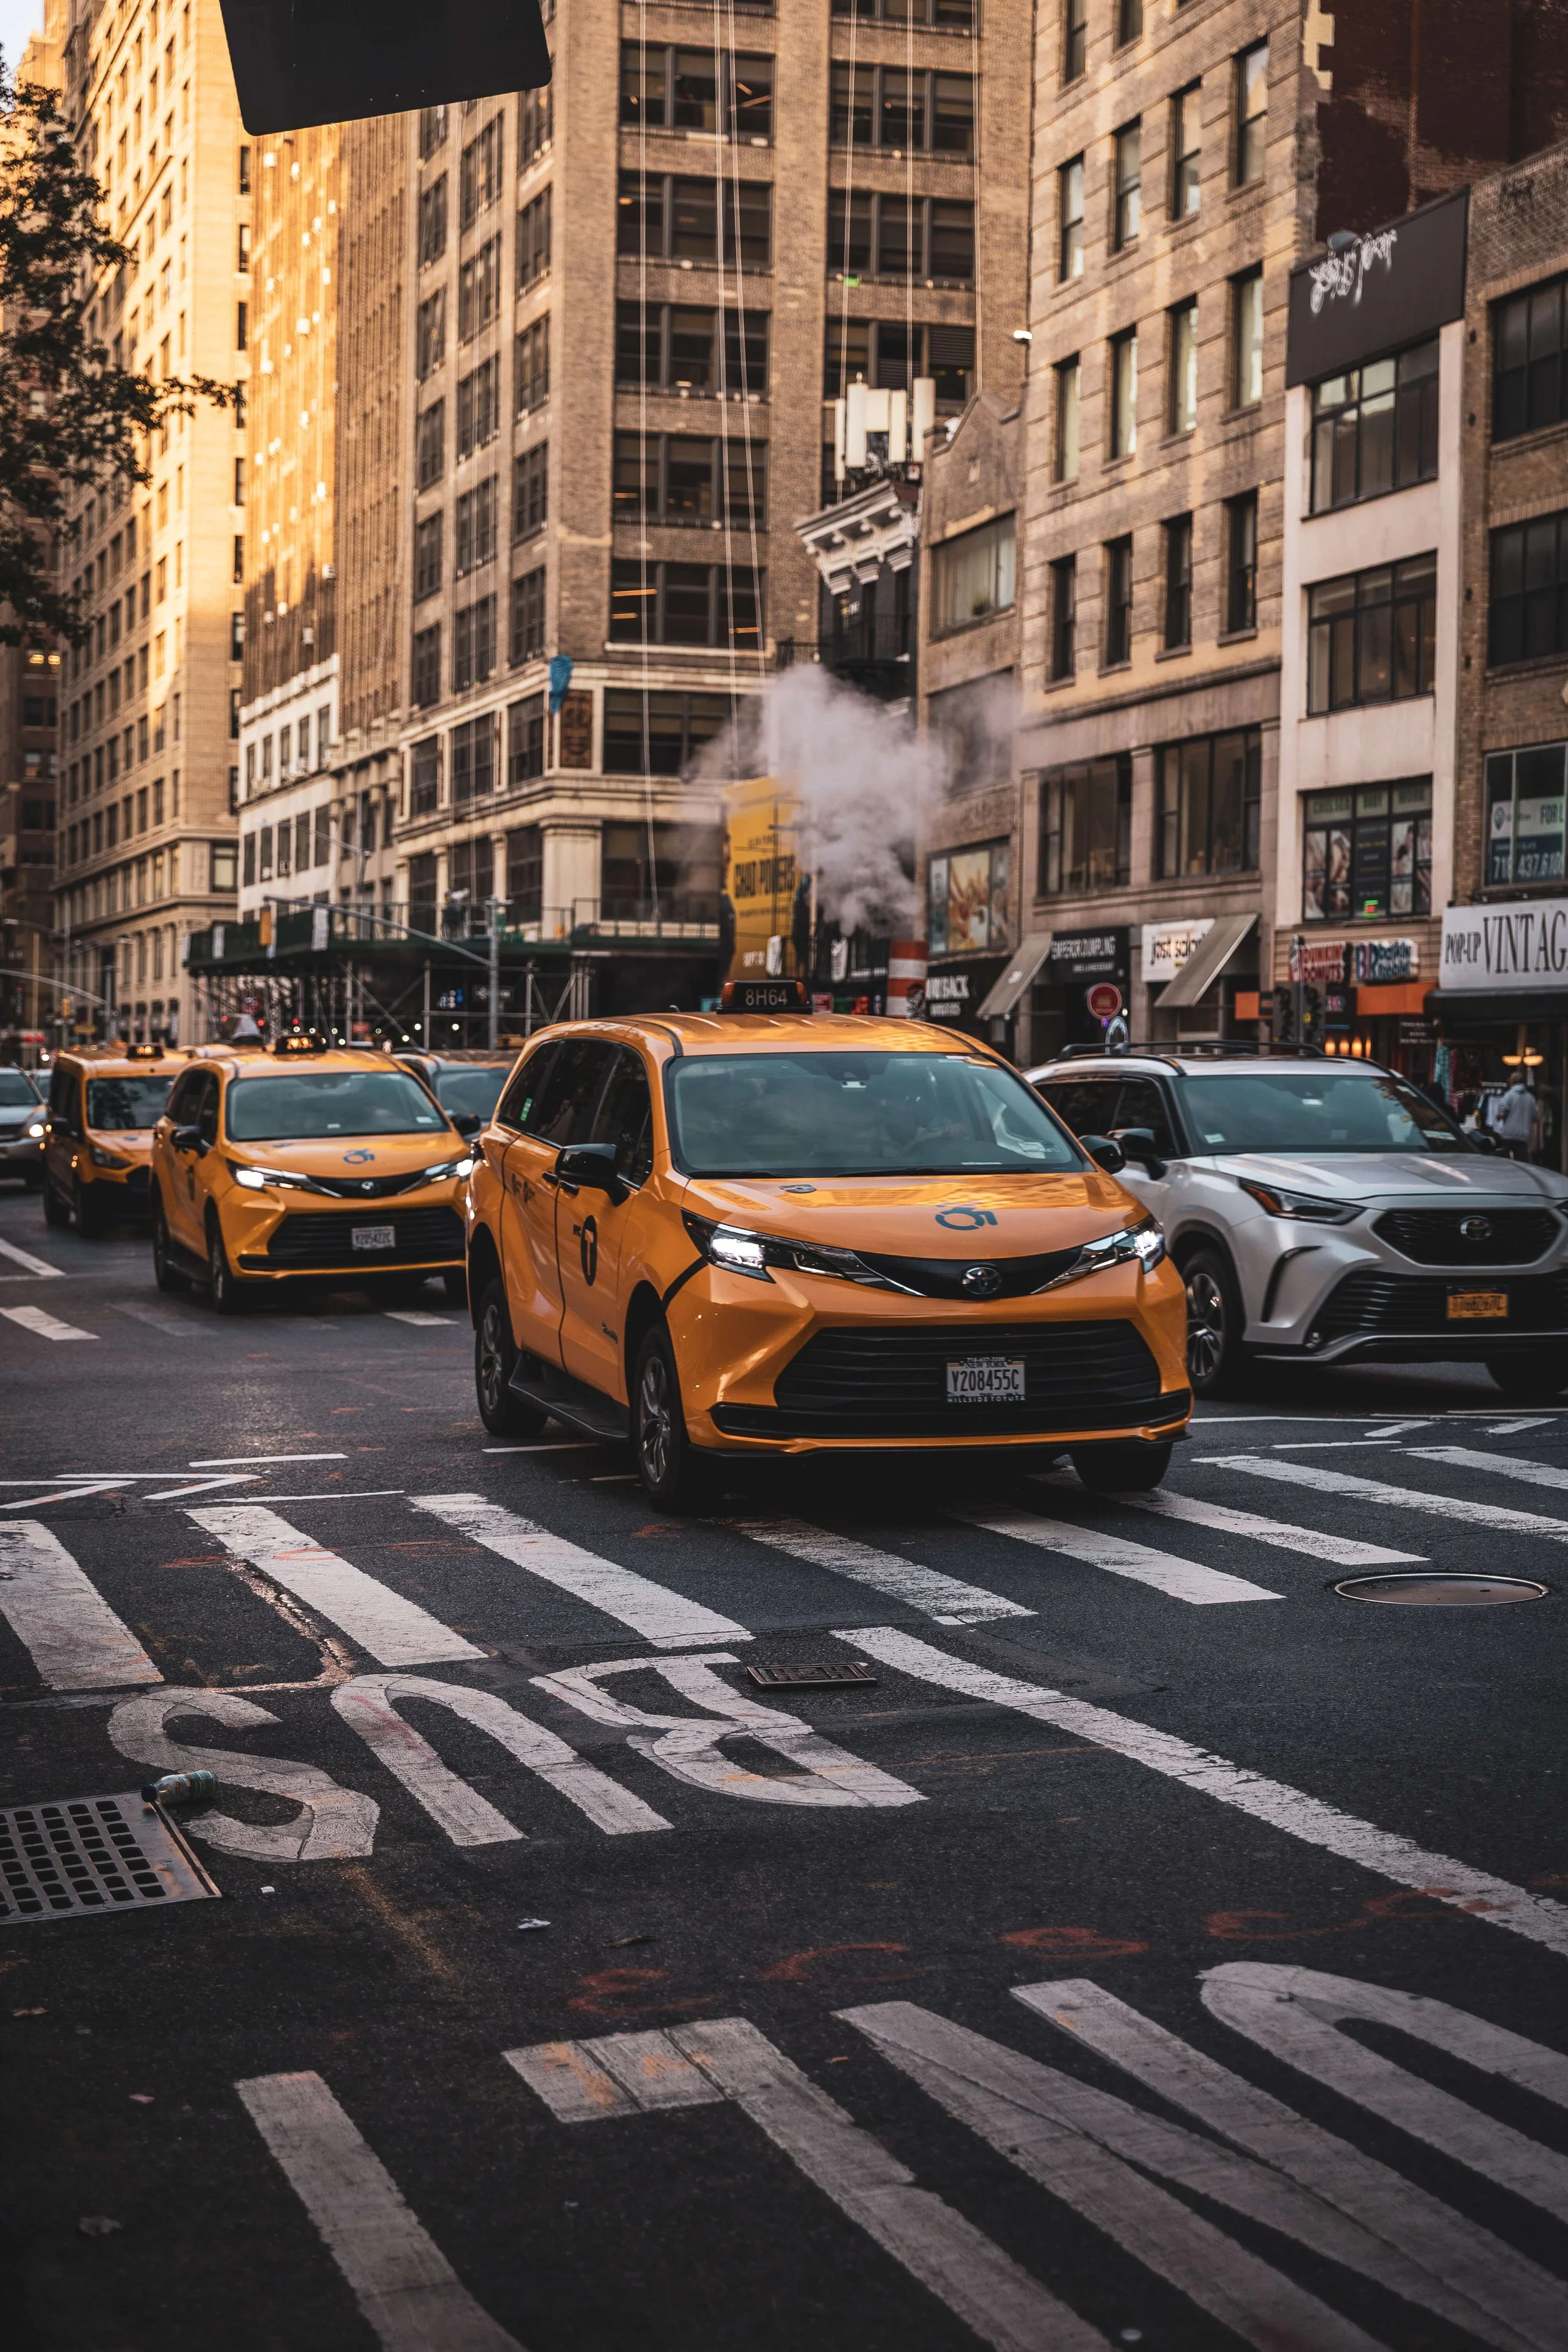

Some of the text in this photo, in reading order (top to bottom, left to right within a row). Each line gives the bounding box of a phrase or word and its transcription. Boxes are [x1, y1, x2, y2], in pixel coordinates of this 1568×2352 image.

[1174, 932, 1208, 958] sala
[1444, 910, 1568, 974] POP-UP VINTAG
[745, 988, 788, 1006] 8H64
[951, 1369, 1019, 1392] Y208455C
[107, 1651, 931, 1862] BUS
